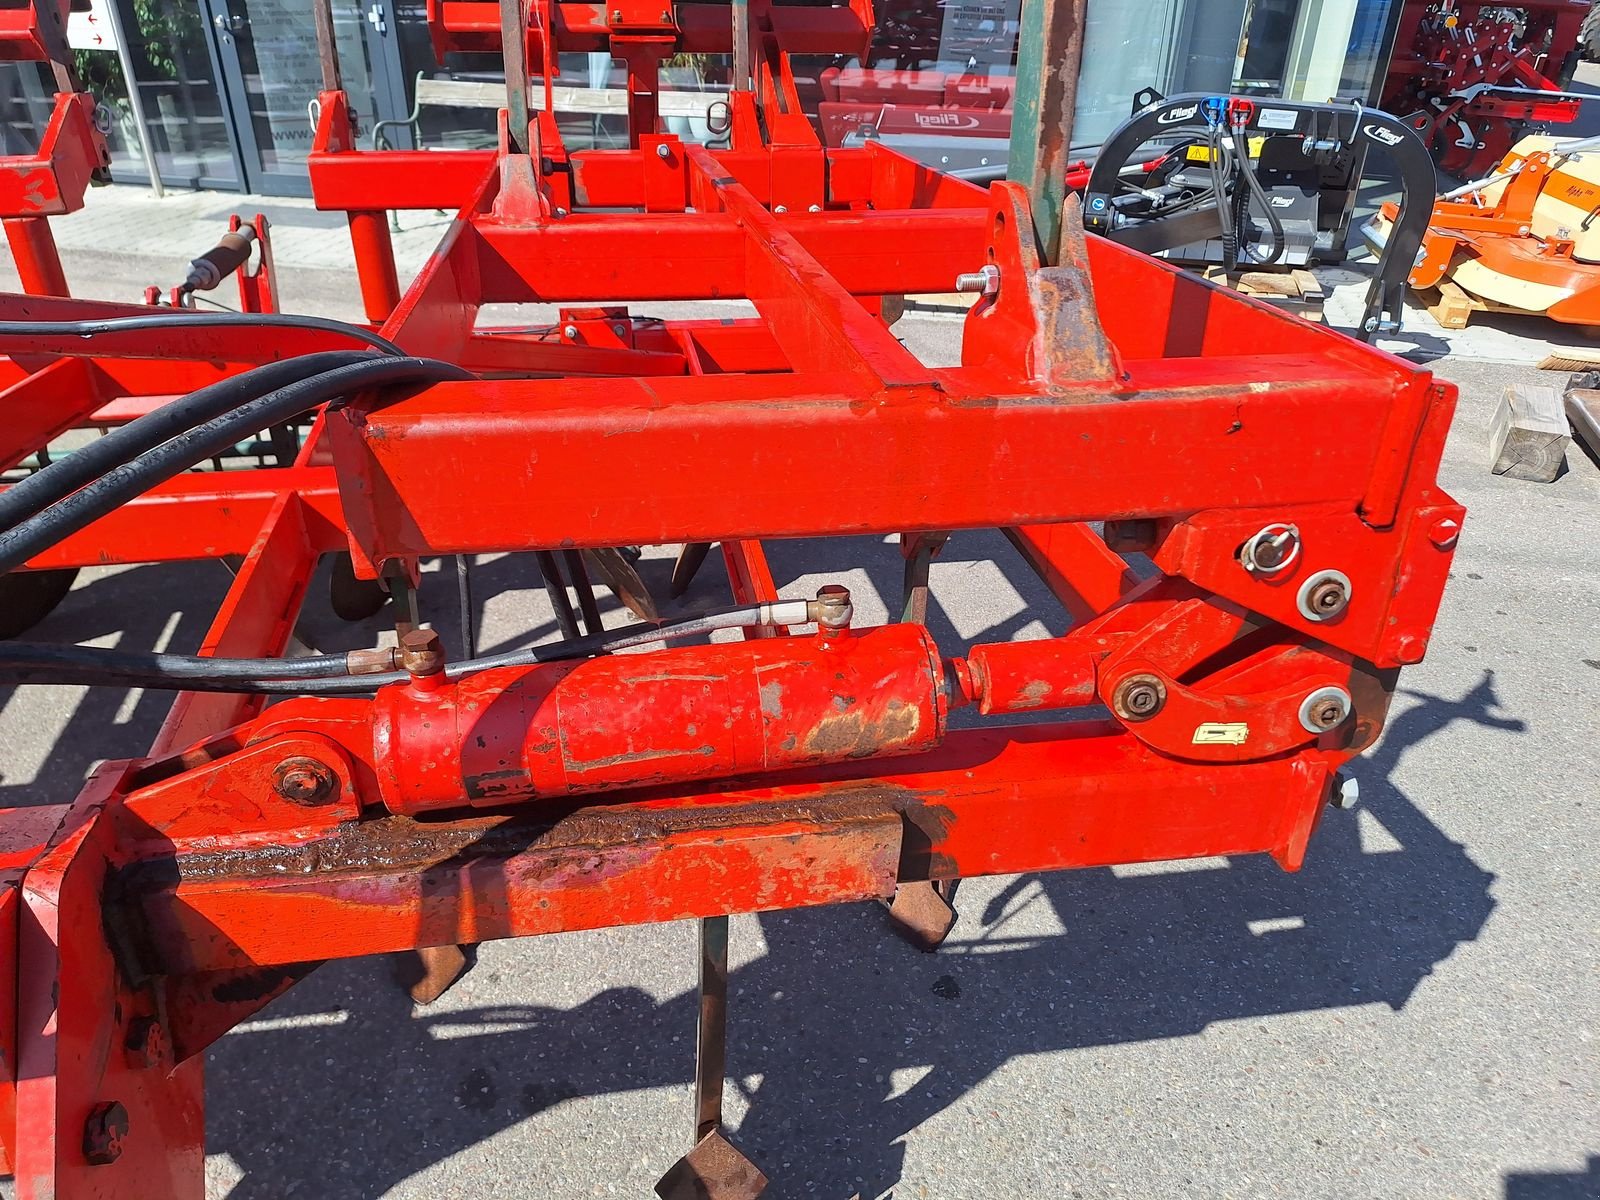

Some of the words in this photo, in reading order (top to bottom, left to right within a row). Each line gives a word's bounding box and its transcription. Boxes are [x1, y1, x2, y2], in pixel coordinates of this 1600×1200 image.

[1168, 104, 1198, 120] Fliegl
[1374, 126, 1405, 146] Fliegl
[1271, 196, 1296, 208] Fliegl
